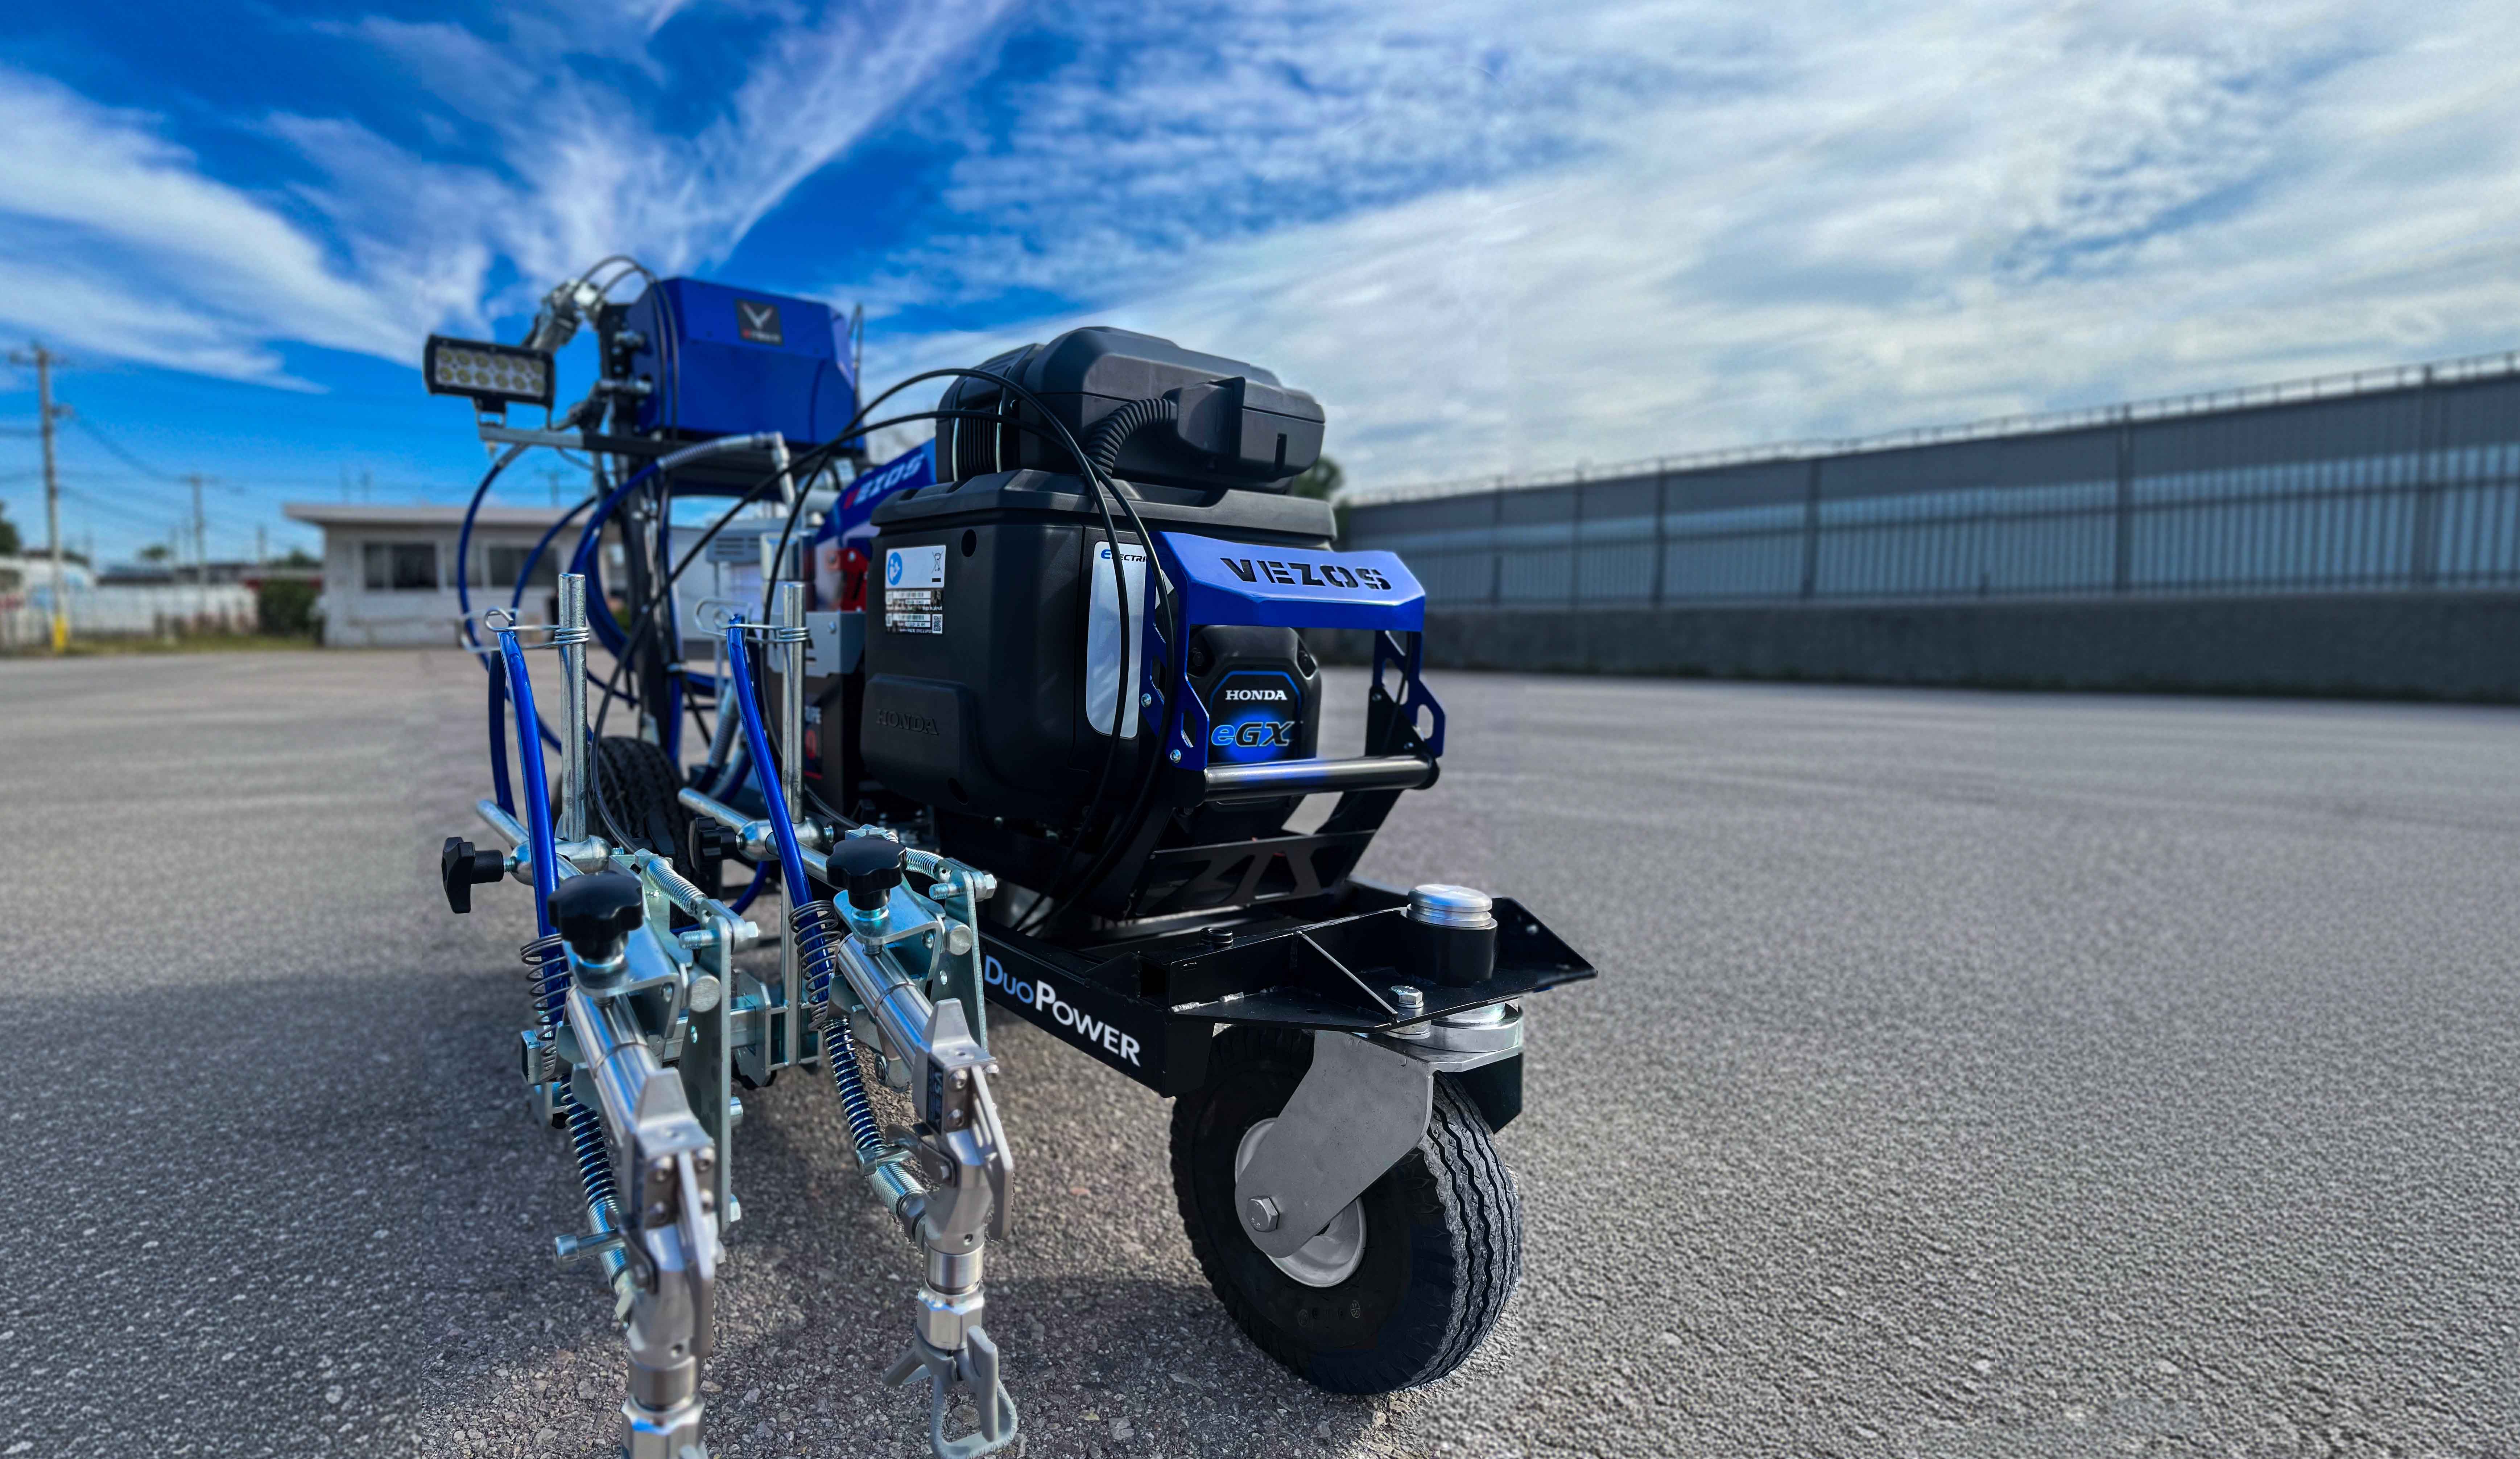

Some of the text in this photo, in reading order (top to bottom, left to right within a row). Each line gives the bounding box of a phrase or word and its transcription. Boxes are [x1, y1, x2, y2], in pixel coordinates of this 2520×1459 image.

[1101, 549, 1147, 562] EECTRI
[1220, 557, 1392, 590] VEZOS
[1225, 690, 1288, 701] HONDA
[876, 710, 938, 735] HONDA
[1211, 721, 1296, 747] eGX
